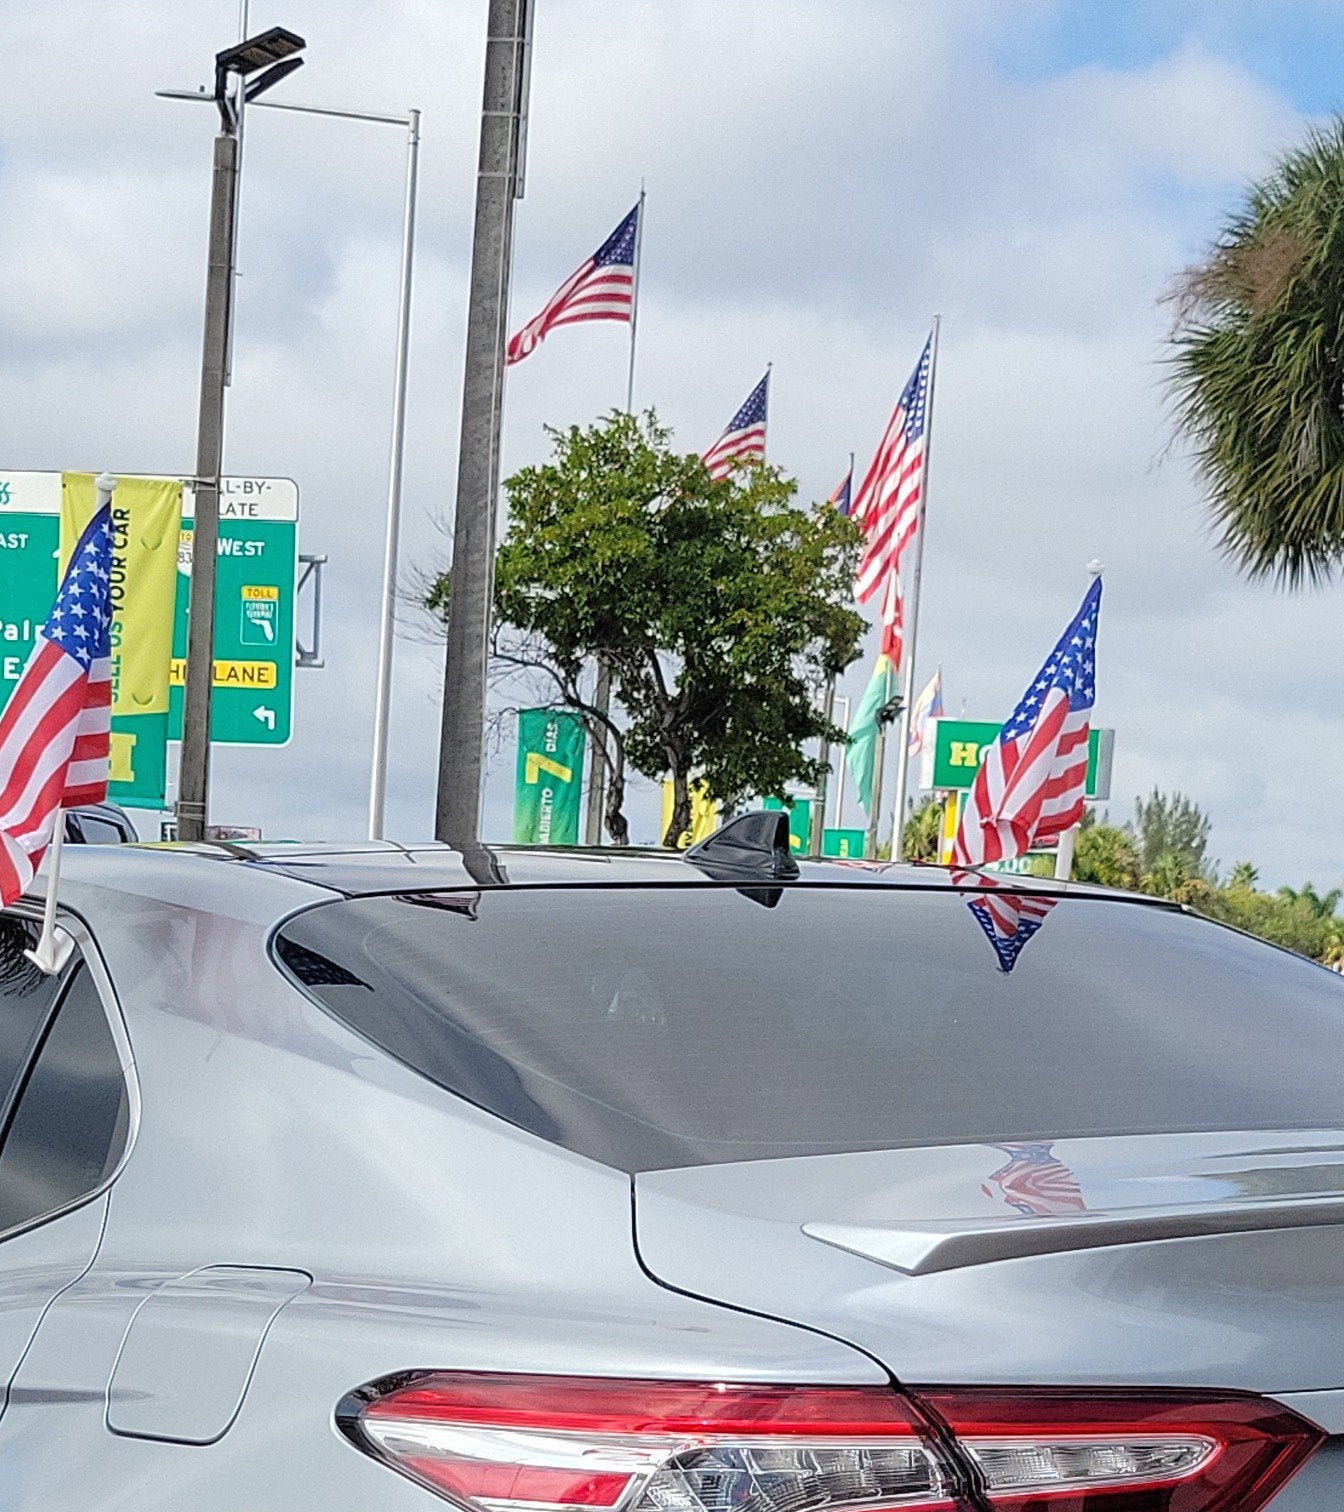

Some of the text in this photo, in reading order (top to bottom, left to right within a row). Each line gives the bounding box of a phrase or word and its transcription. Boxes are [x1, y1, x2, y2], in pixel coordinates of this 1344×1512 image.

[112, 508, 130, 550] CAR
[217, 538, 266, 557] WEST
[178, 551, 193, 564] 83
[109, 556, 128, 611] YOUR
[246, 588, 274, 599] TOLL
[212, 666, 270, 684] LANE
[525, 752, 572, 785] 7
